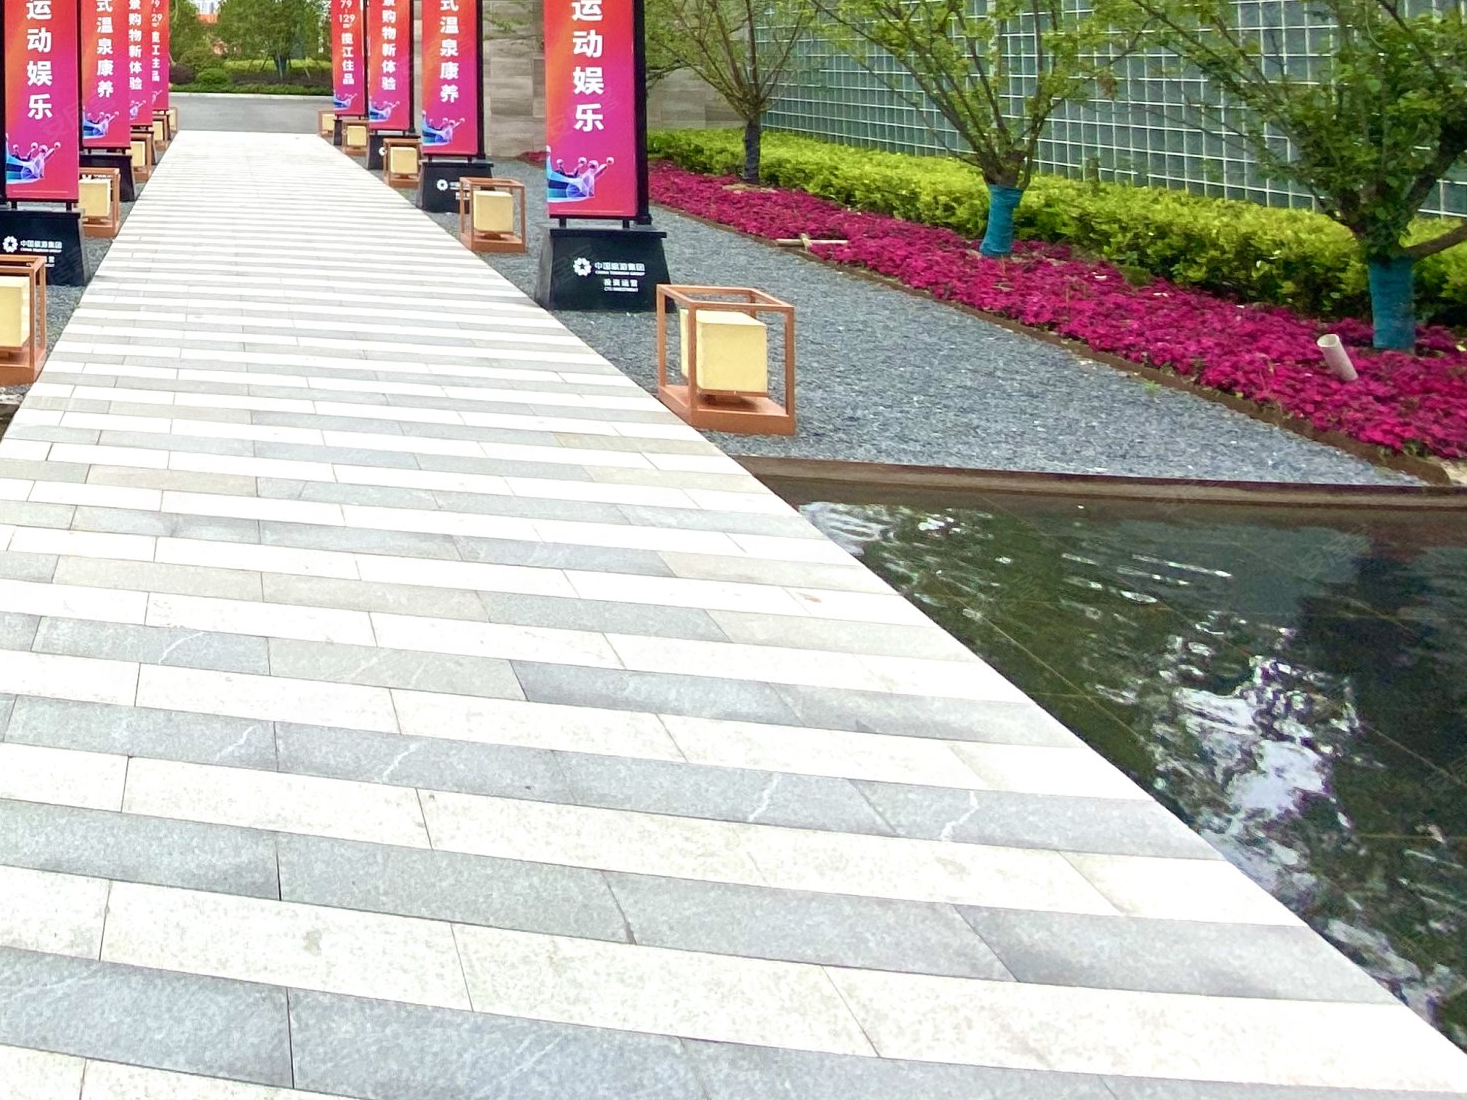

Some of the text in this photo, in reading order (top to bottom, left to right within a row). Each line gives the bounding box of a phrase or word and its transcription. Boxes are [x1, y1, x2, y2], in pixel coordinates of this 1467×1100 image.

[340, 0, 352, 9] 79
[151, 13, 162, 23] 29
[338, 14, 355, 23] 129
